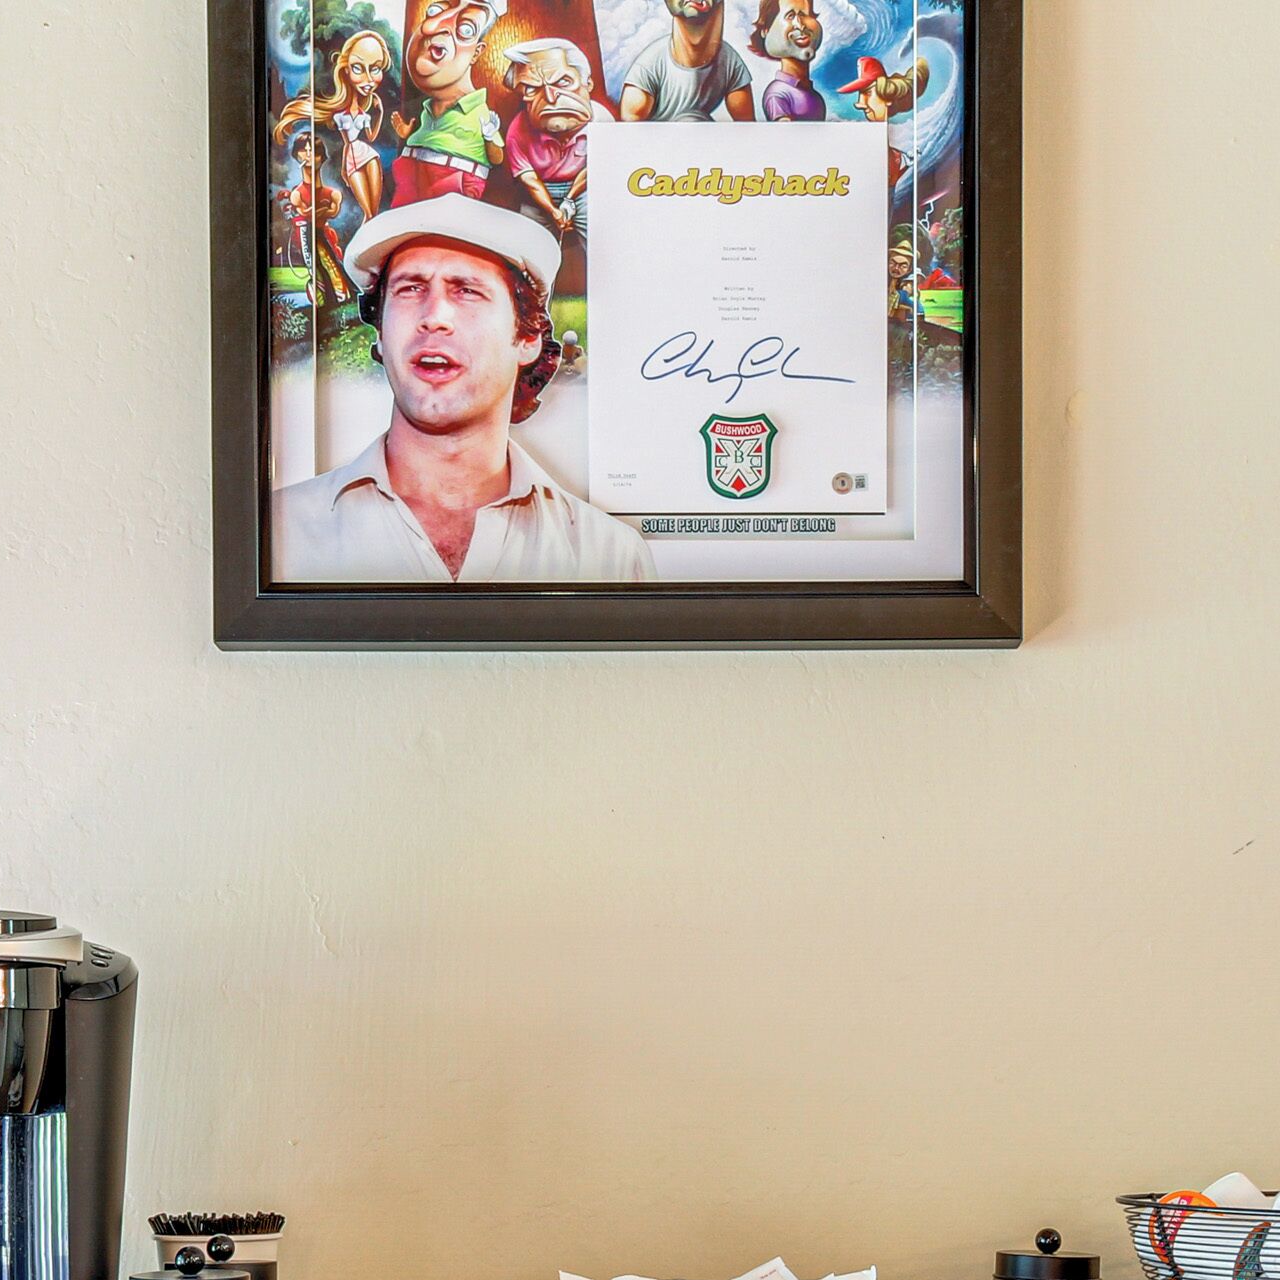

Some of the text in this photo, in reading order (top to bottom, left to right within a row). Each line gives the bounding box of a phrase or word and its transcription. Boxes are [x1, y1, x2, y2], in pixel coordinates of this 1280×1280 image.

[627, 167, 850, 204] Caddyshack
[715, 423, 762, 435] BUSHWOOD
[734, 449, 744, 463] B
[642, 518, 836, 532] SOME PEOPLE JUST DON'T BELONG
